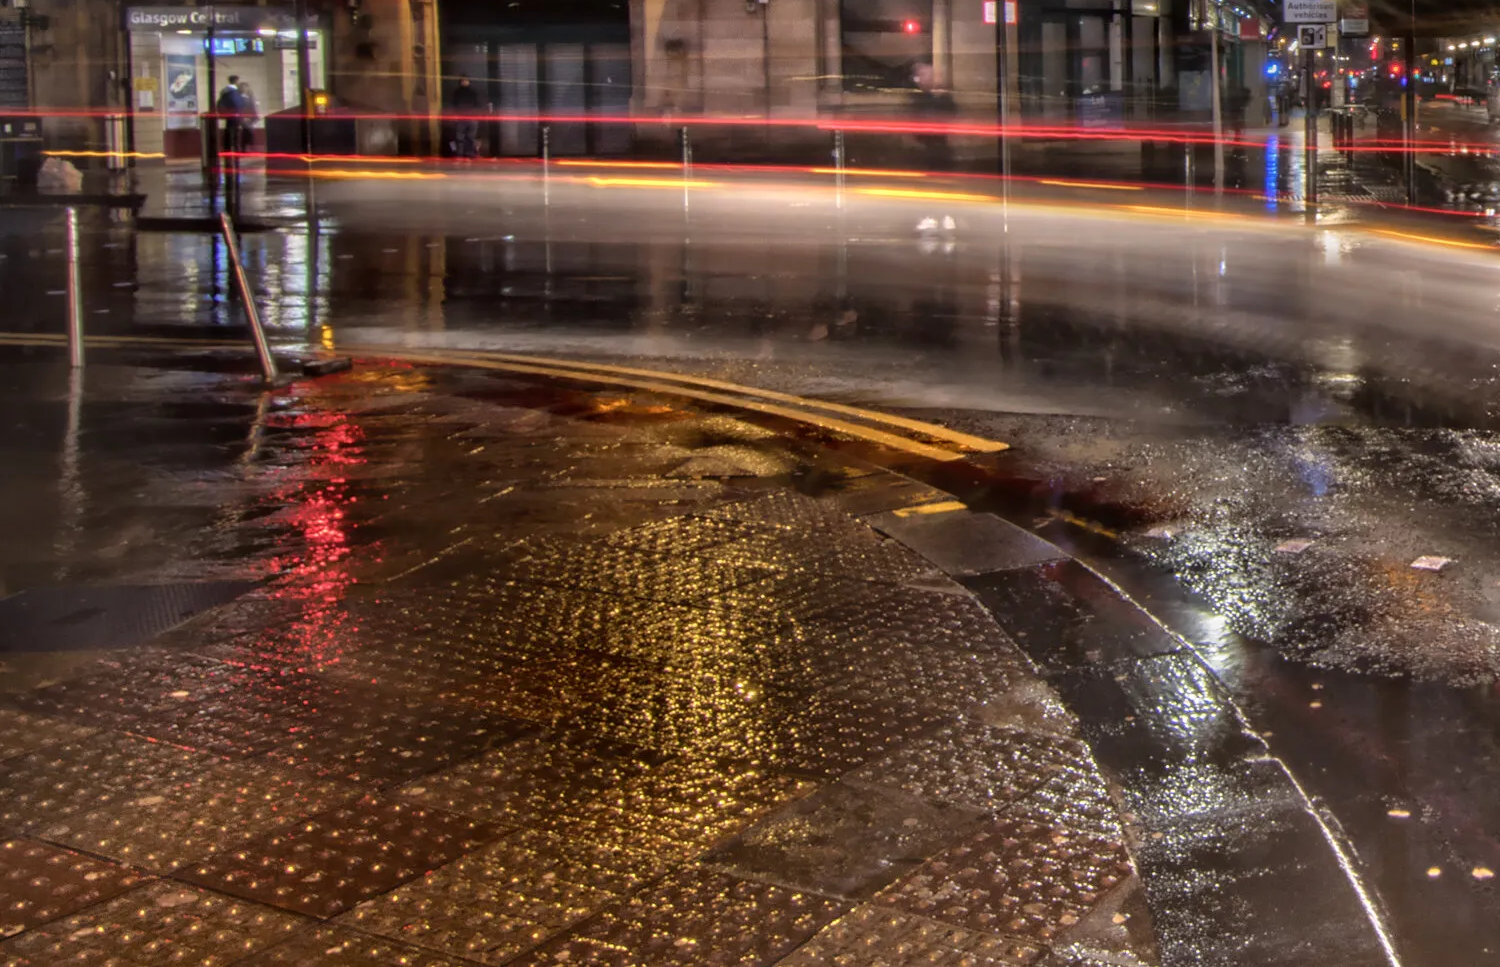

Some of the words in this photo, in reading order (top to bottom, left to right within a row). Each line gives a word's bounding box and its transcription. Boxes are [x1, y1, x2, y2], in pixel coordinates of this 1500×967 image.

[1287, 2, 1334, 11] Authorised
[131, 11, 188, 27] Glasgow
[190, 11, 240, 24] Cetral
[1294, 11, 1328, 19] vehicles
